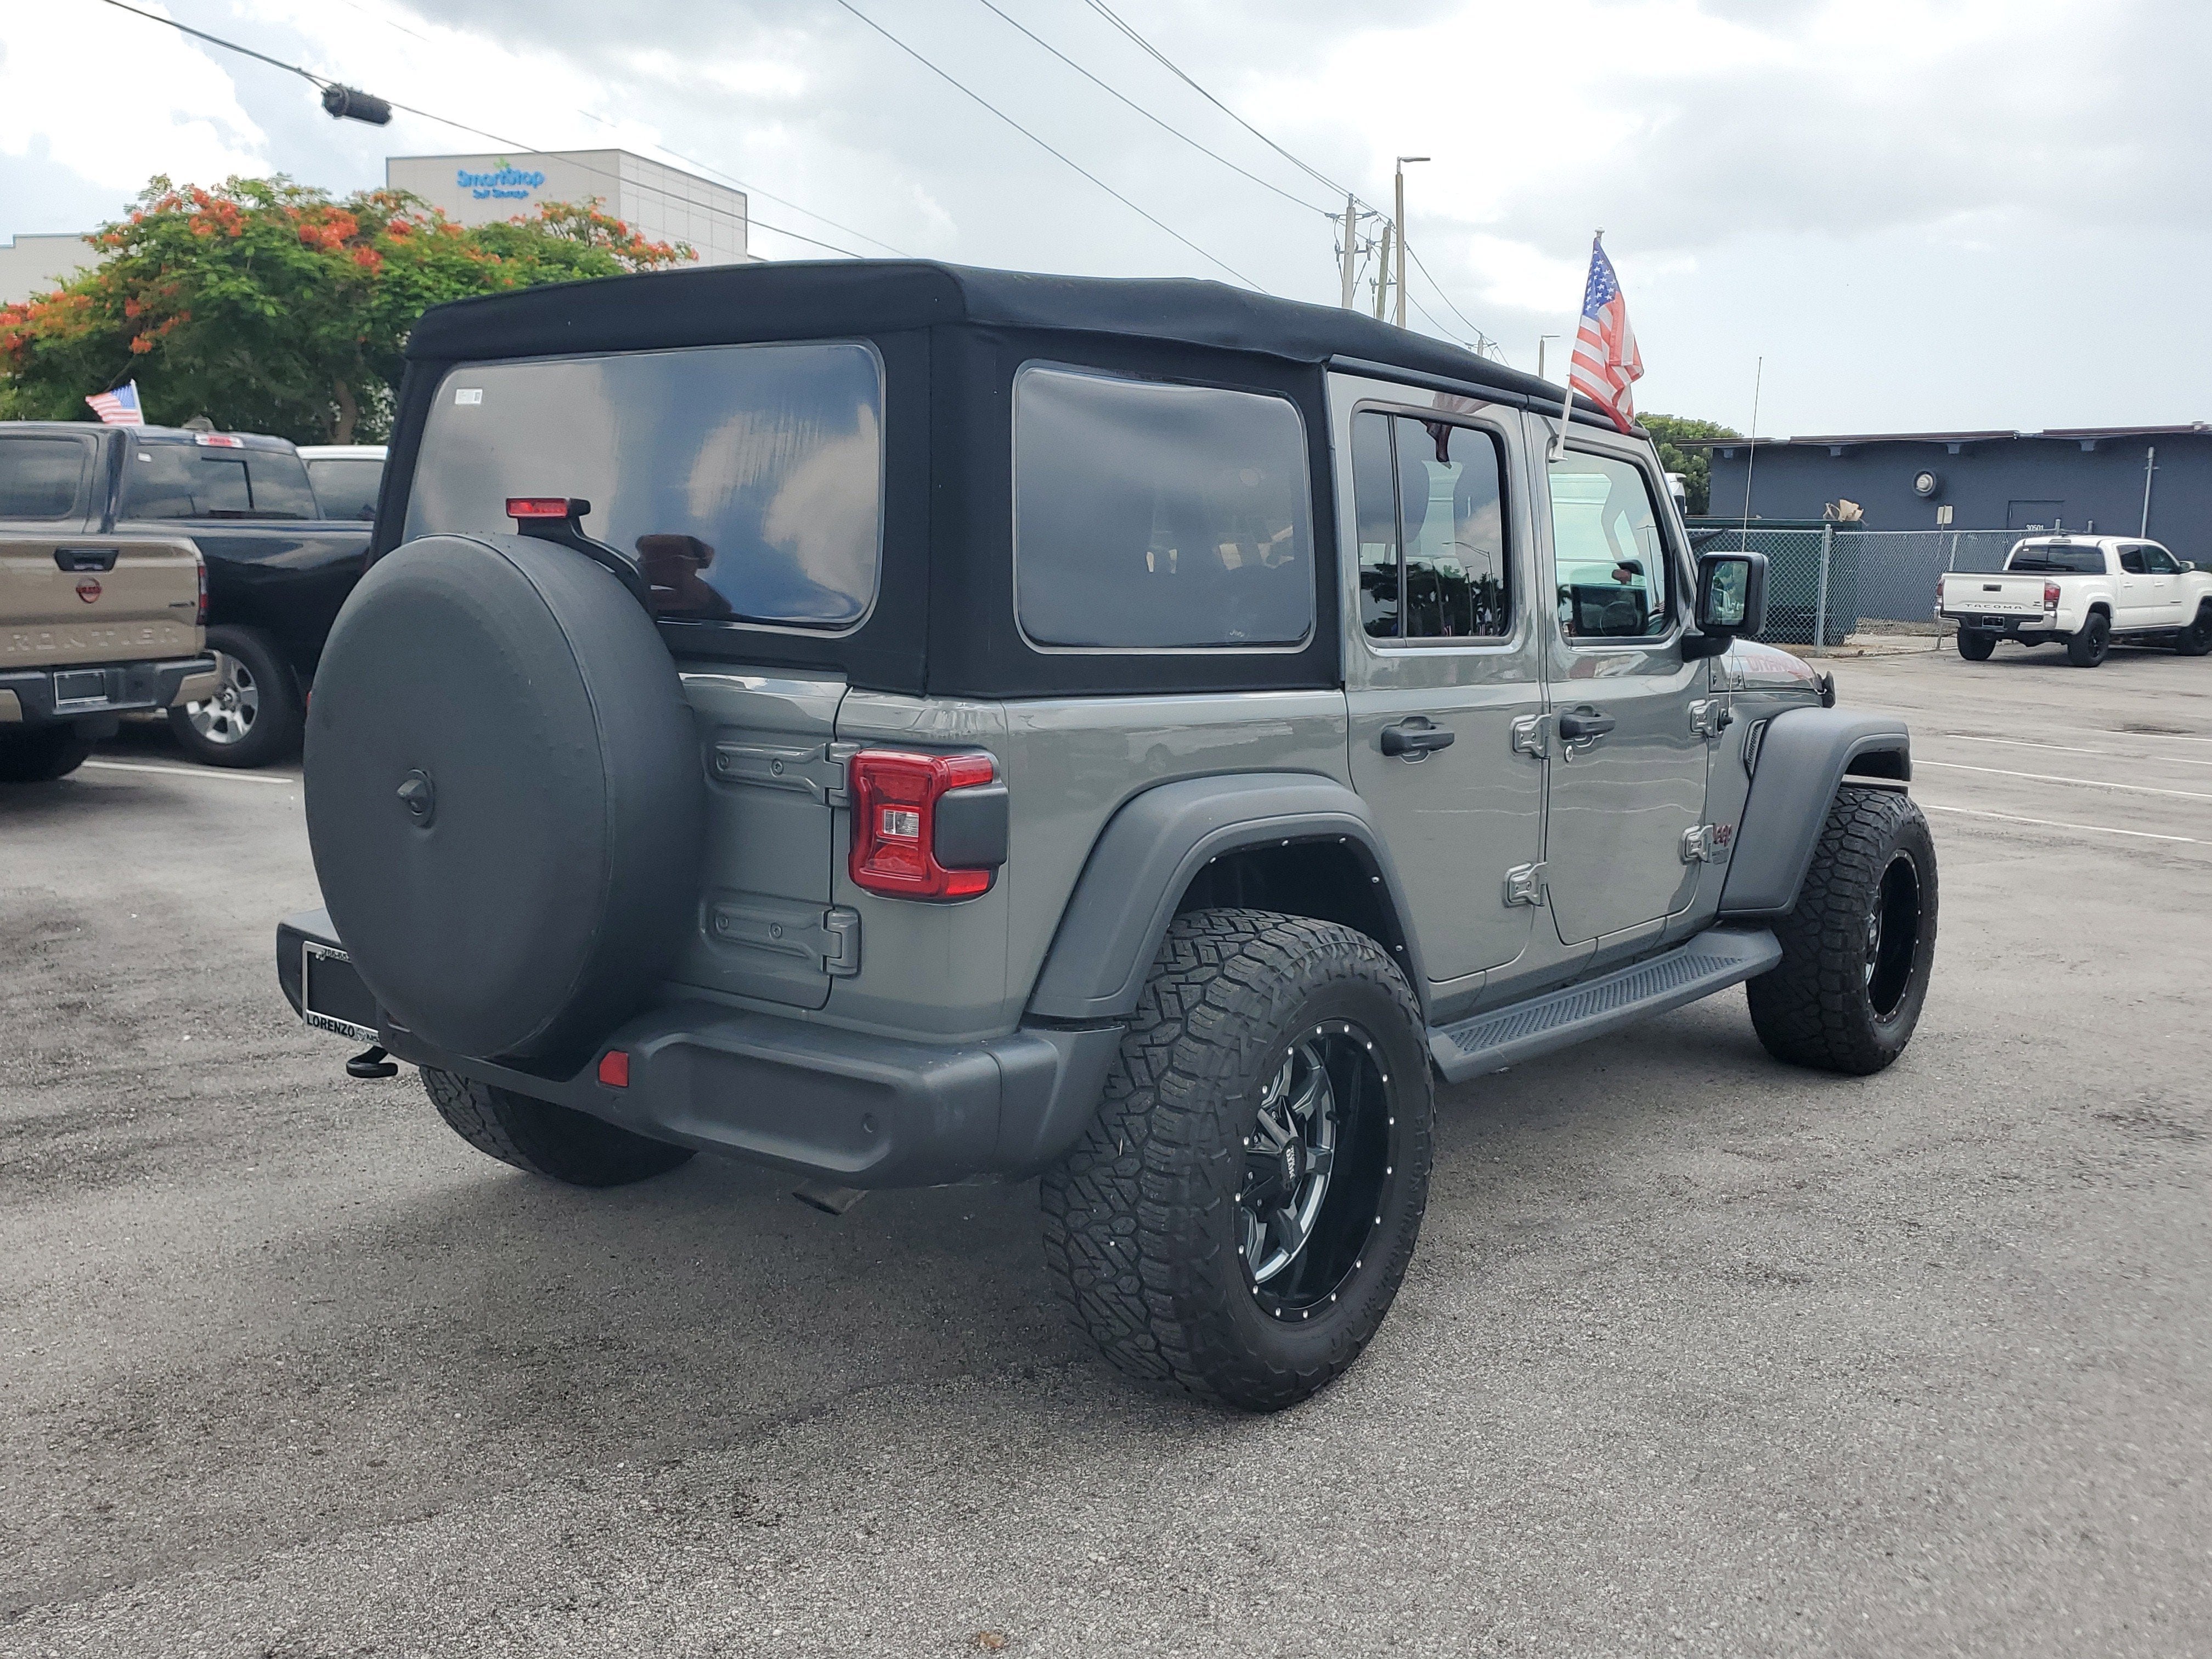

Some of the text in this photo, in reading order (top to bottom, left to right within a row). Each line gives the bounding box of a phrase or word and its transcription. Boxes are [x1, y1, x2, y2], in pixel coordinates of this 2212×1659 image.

[457, 168, 544, 189] SmartStop
[306, 1013, 355, 1038] LORENZO
[1286, 1148, 1295, 1180] MOTO
